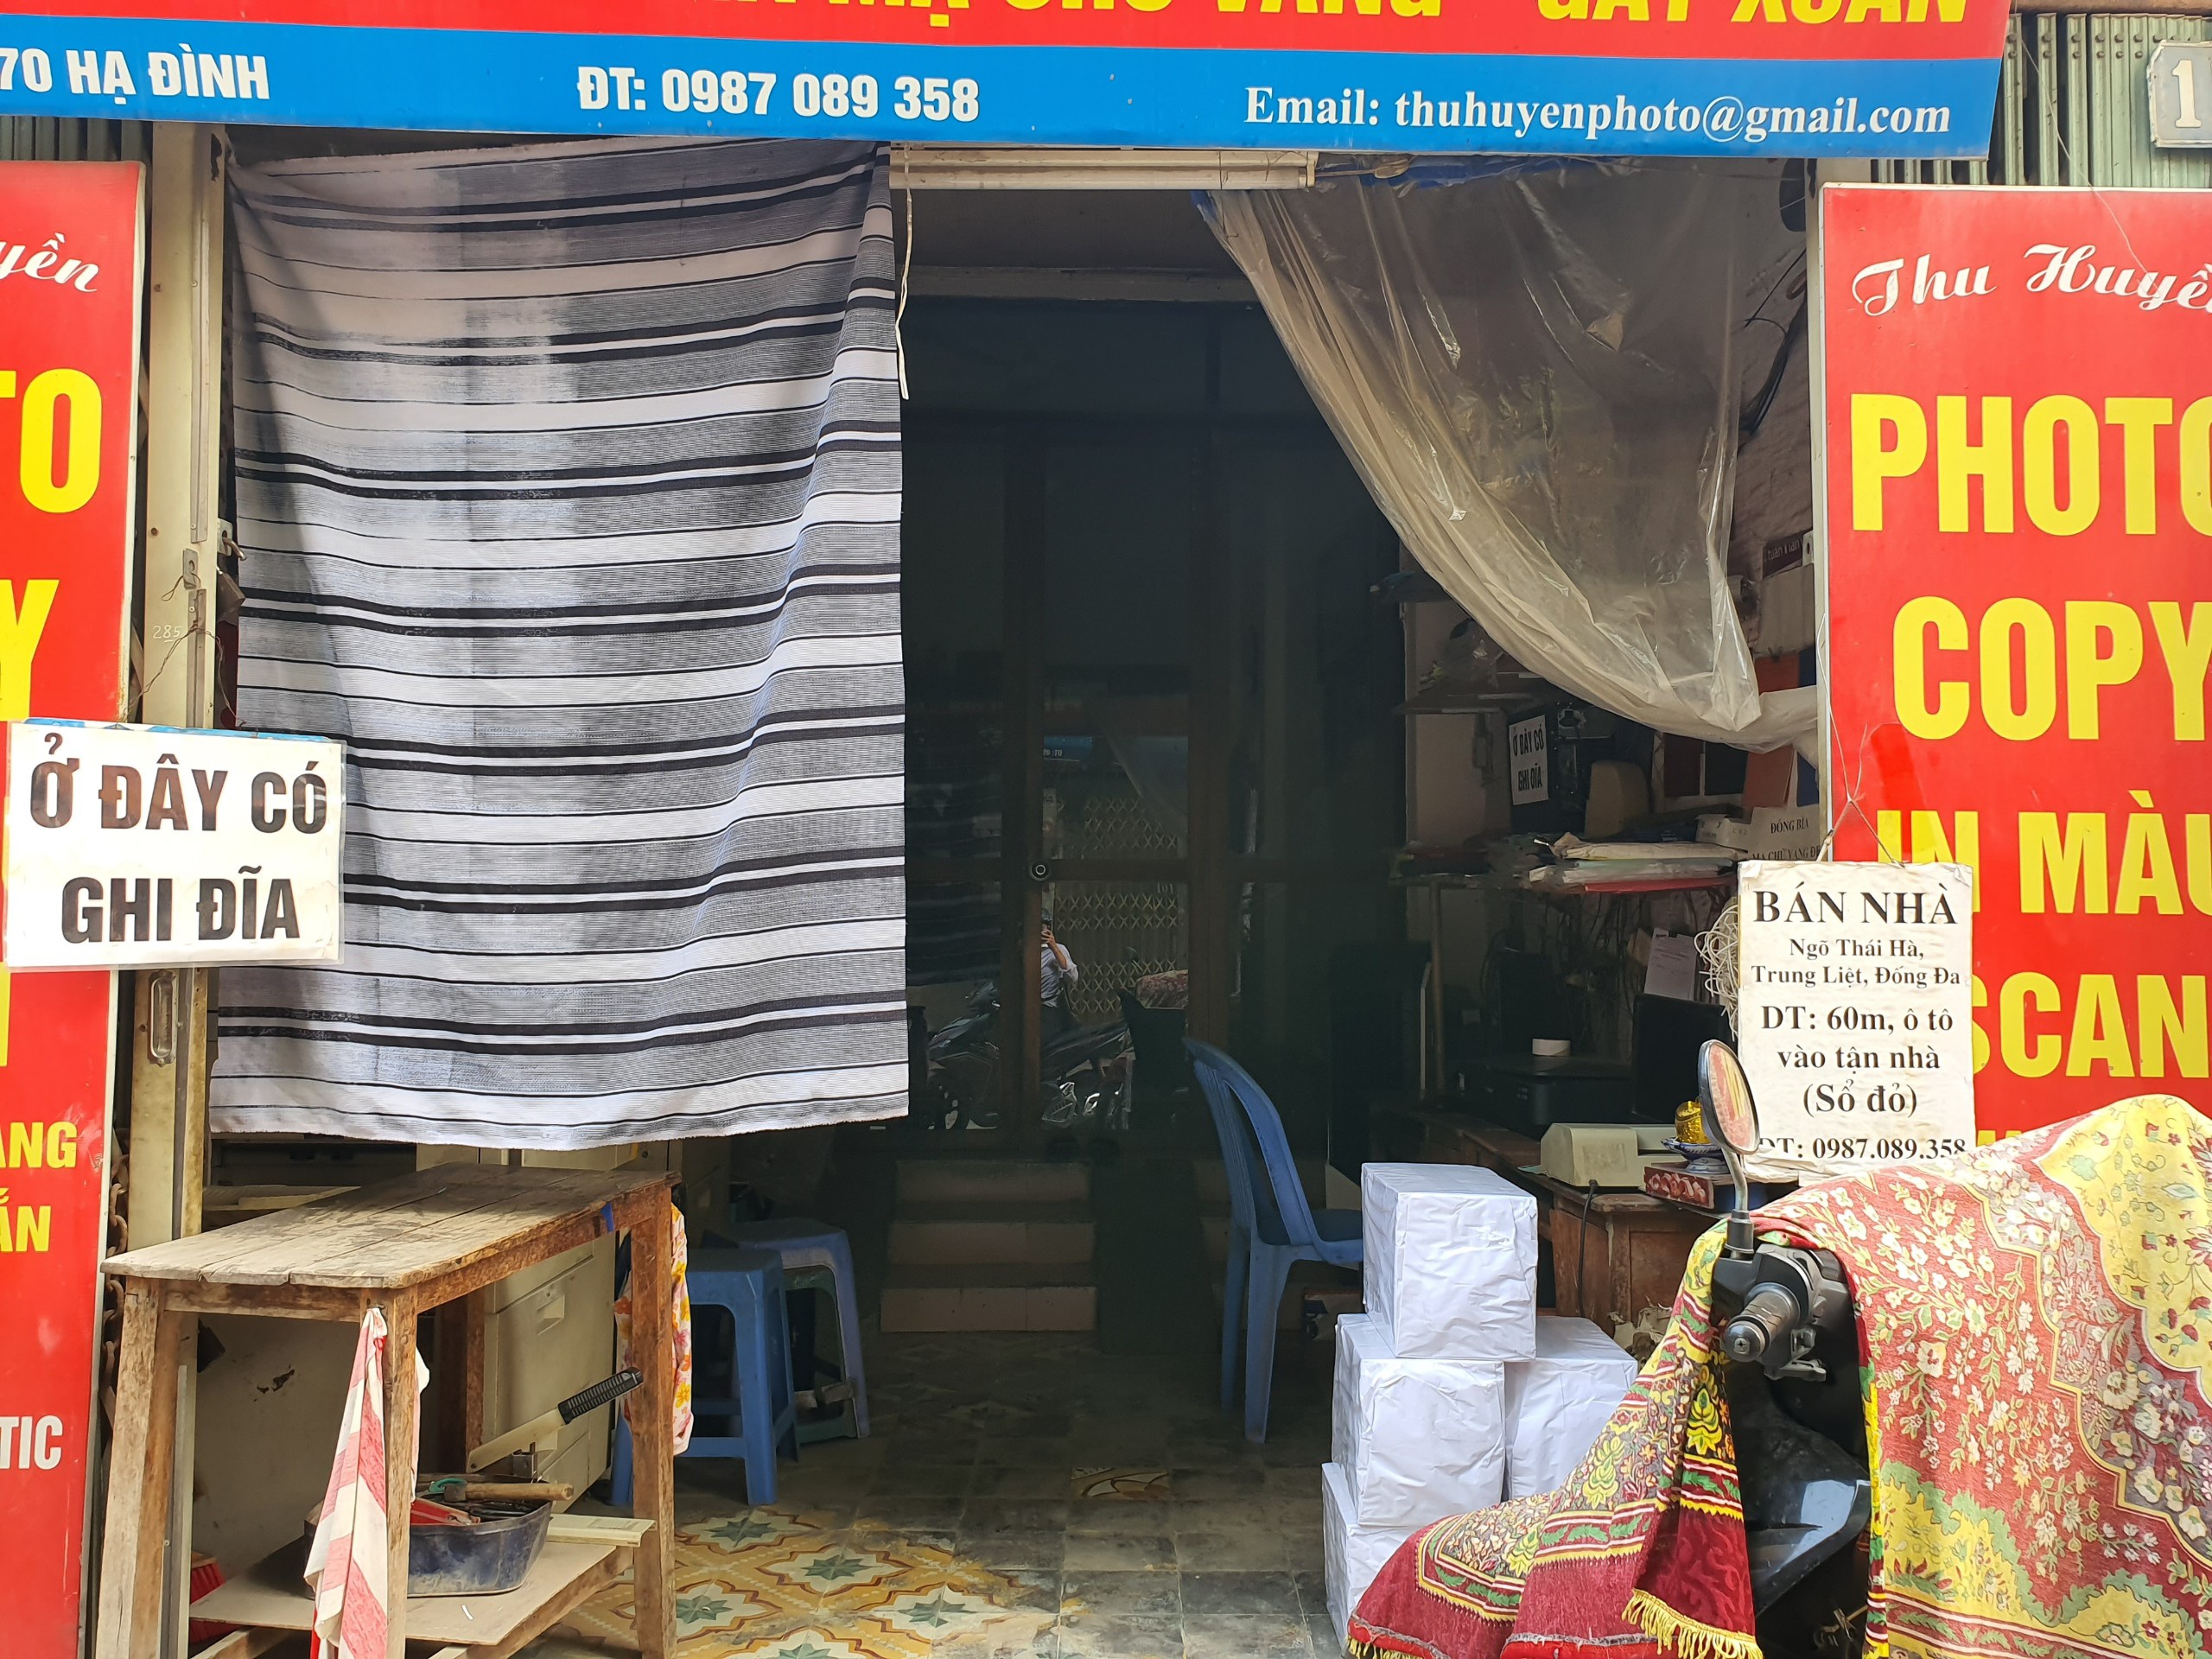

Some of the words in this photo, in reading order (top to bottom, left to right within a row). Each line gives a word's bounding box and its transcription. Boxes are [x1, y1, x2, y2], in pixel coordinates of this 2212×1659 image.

[0, 48, 52, 92] 70
[66, 49, 137, 105] HẠ
[148, 43, 270, 99] ĐÌNH
[576, 67, 646, 111] ĐT:
[662, 69, 776, 115] 0987
[792, 73, 880, 118] 089
[894, 77, 980, 122] 358
[1243, 86, 1381, 126] Email:
[1394, 91, 1951, 144] thuhuyenphoto@gmail.com
[1852, 253, 1997, 317] Thu
[2024, 243, 2212, 315] Huyề
[0, 368, 103, 513] O
[153, 625, 181, 639] 285
[1893, 595, 2212, 741] COPY
[30, 733, 79, 828] Ở
[99, 753, 228, 831] ĐÂY
[251, 760, 327, 834] CÓ
[61, 876, 173, 944] GHI
[196, 865, 300, 940] ĐĨA
[1752, 881, 1847, 923] BÁN
[1860, 882, 1958, 925] NHÀ
[1789, 938, 1829, 960] Ngõ
[1836, 938, 1883, 957] Thái
[1889, 939, 1924, 959] Hà,
[1751, 965, 1816, 986] Trung
[1822, 966, 1868, 988] Liệt,
[1874, 965, 1927, 988] Đống
[1934, 967, 1961, 984] Đa
[1761, 1006, 1816, 1030] DT:
[1827, 1006, 1894, 1033] 60m,
[1904, 1009, 1918, 1031] ô
[1929, 1007, 1953, 1031] tô
[1972, 972, 2209, 1077] CAN
[1777, 1045, 1826, 1069] vào
[1836, 1046, 1879, 1074] tận
[1890, 1046, 1940, 1069] nhà
[1802, 1079, 1855, 1117] (Sổ
[1866, 1082, 1917, 1117] đỏ)
[0, 1121, 78, 1168] NG
[1812, 1137, 1966, 1159] 0987.089.358
